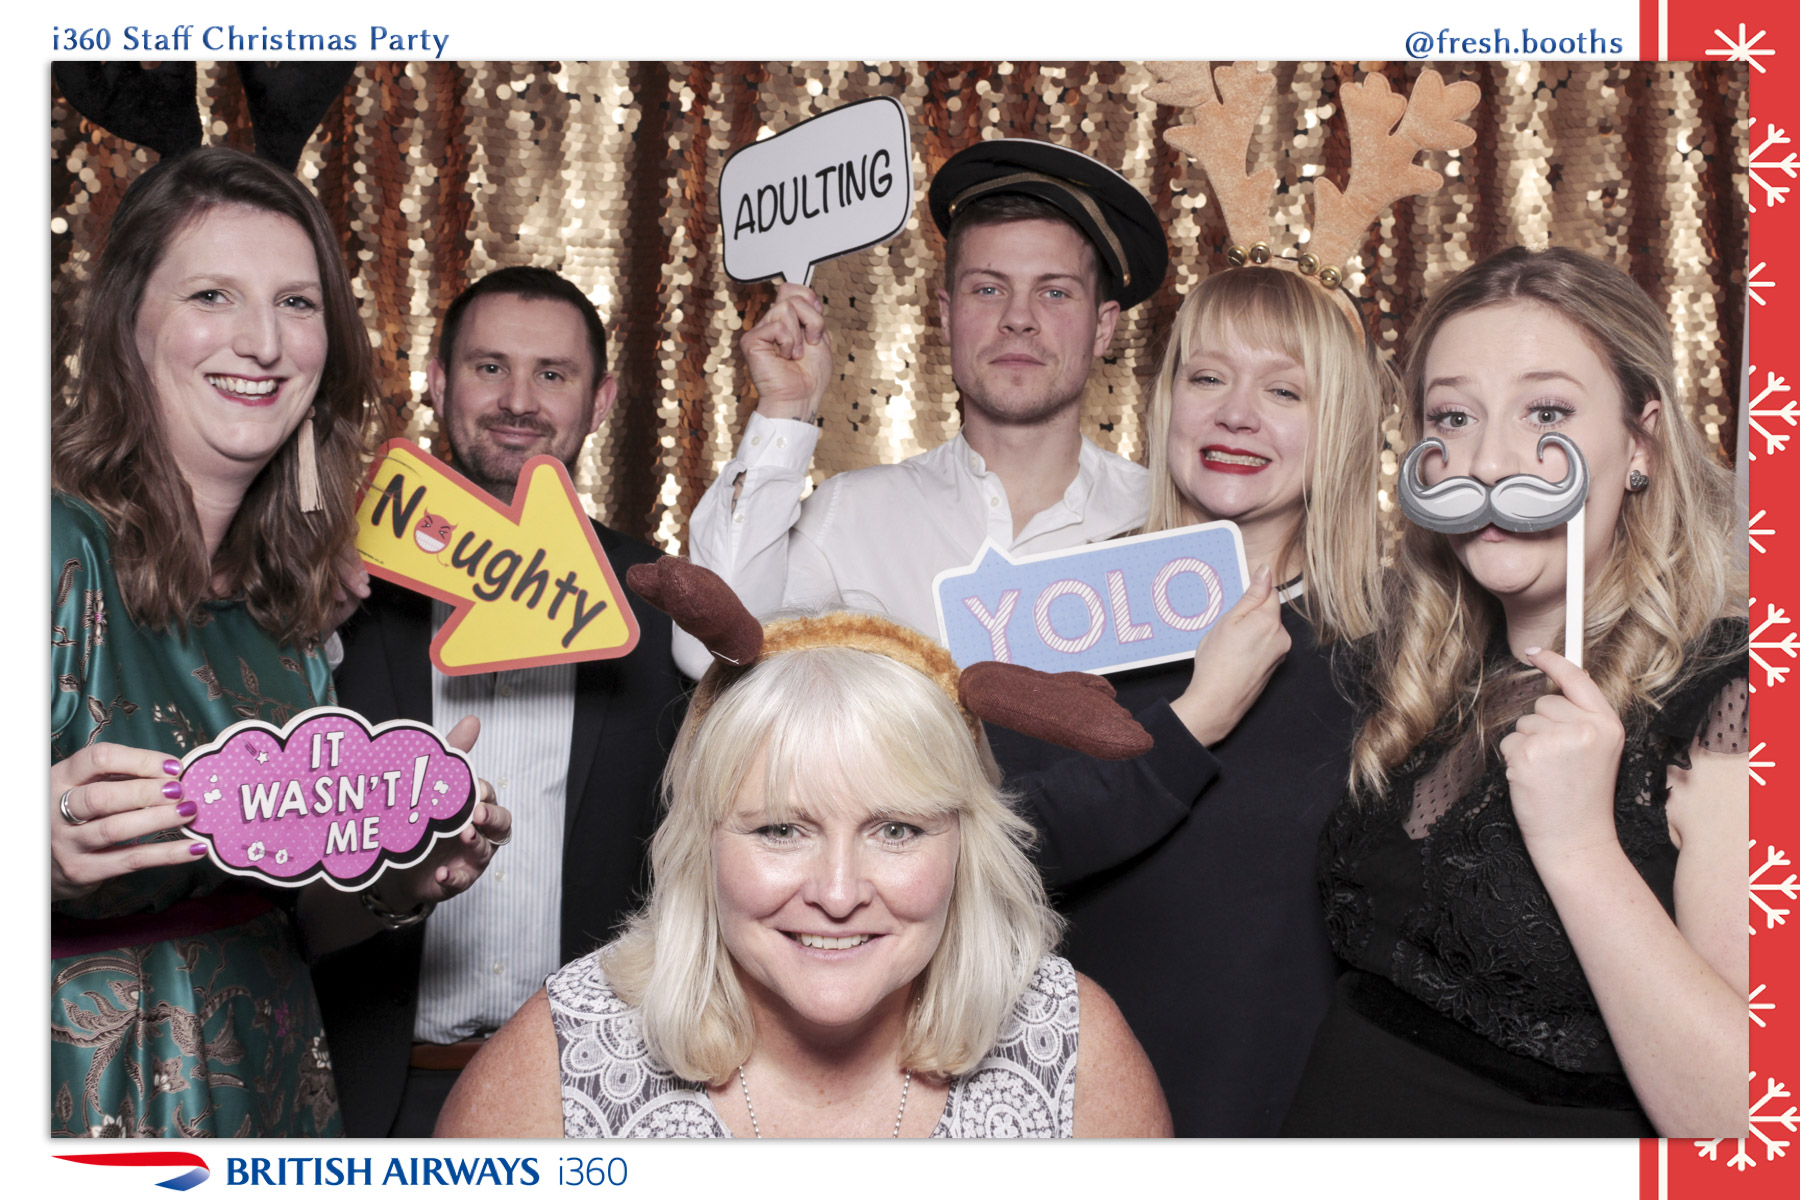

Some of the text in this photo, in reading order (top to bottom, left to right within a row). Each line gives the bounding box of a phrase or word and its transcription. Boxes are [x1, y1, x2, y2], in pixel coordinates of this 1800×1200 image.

[734, 149, 892, 240] ADULTING
[371, 473, 607, 648] Nughty
[962, 557, 1224, 664] YOLO
[311, 731, 345, 769] IT
[325, 816, 380, 855] ME
